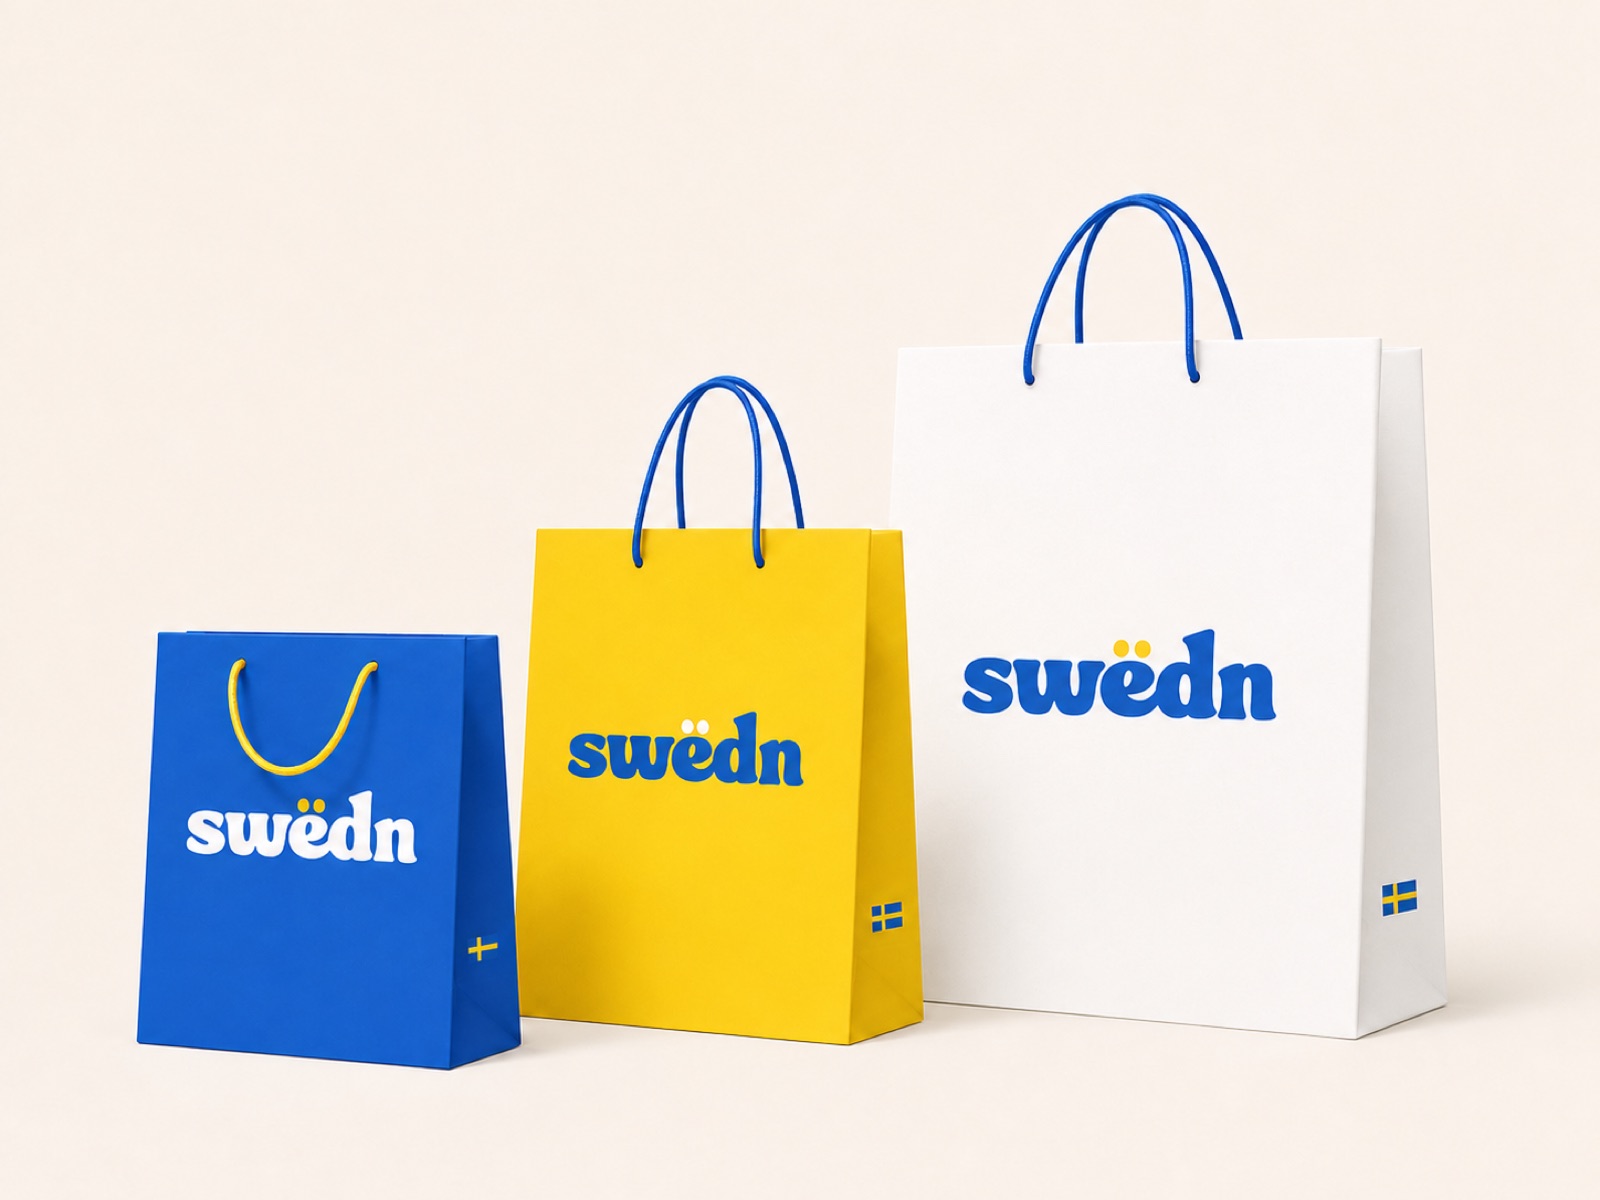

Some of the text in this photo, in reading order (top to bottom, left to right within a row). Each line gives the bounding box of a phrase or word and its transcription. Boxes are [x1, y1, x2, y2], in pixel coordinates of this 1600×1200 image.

[962, 629, 1276, 721] swëdn
[567, 711, 803, 787] swëdn
[186, 790, 417, 864] swëdn
